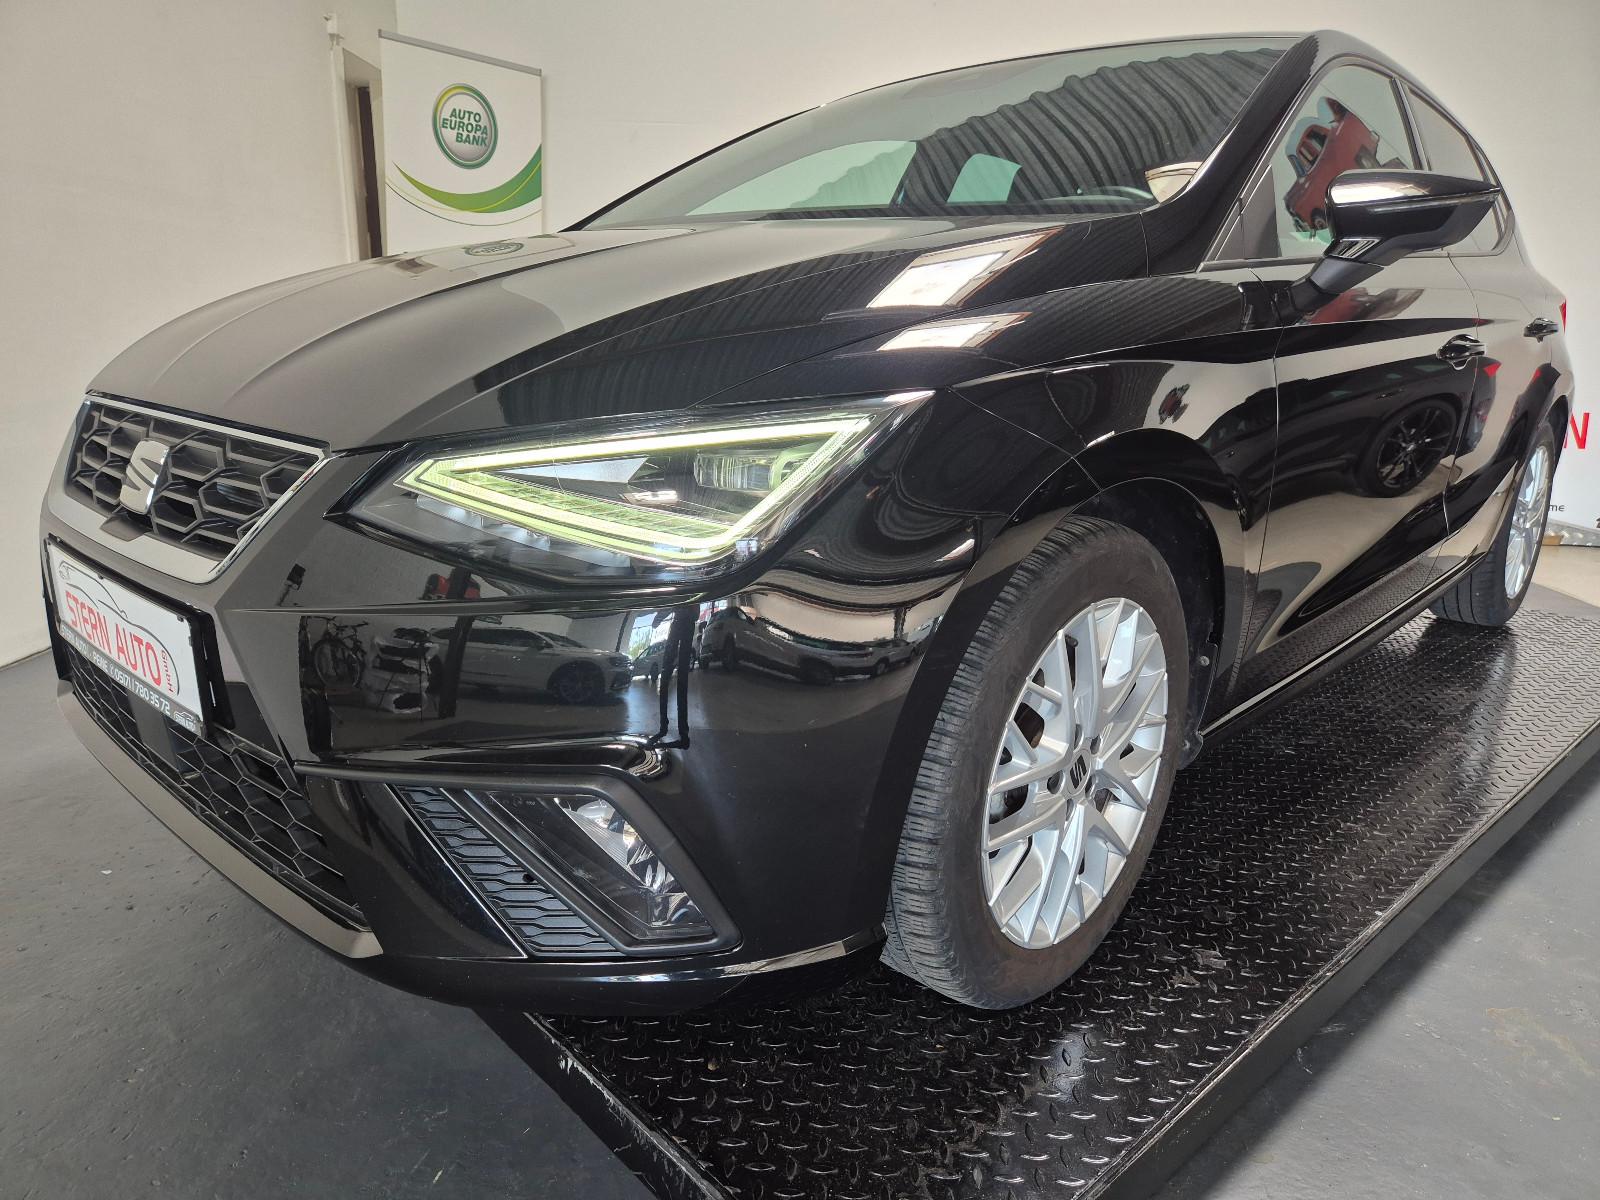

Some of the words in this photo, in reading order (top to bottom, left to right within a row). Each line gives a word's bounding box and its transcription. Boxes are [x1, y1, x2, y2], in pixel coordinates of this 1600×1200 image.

[449, 107, 482, 123] AUTO
[441, 117, 488, 136] EUROPA
[455, 131, 488, 147] BANK
[65, 590, 112, 655] STERN
[115, 623, 162, 687] AUTO
